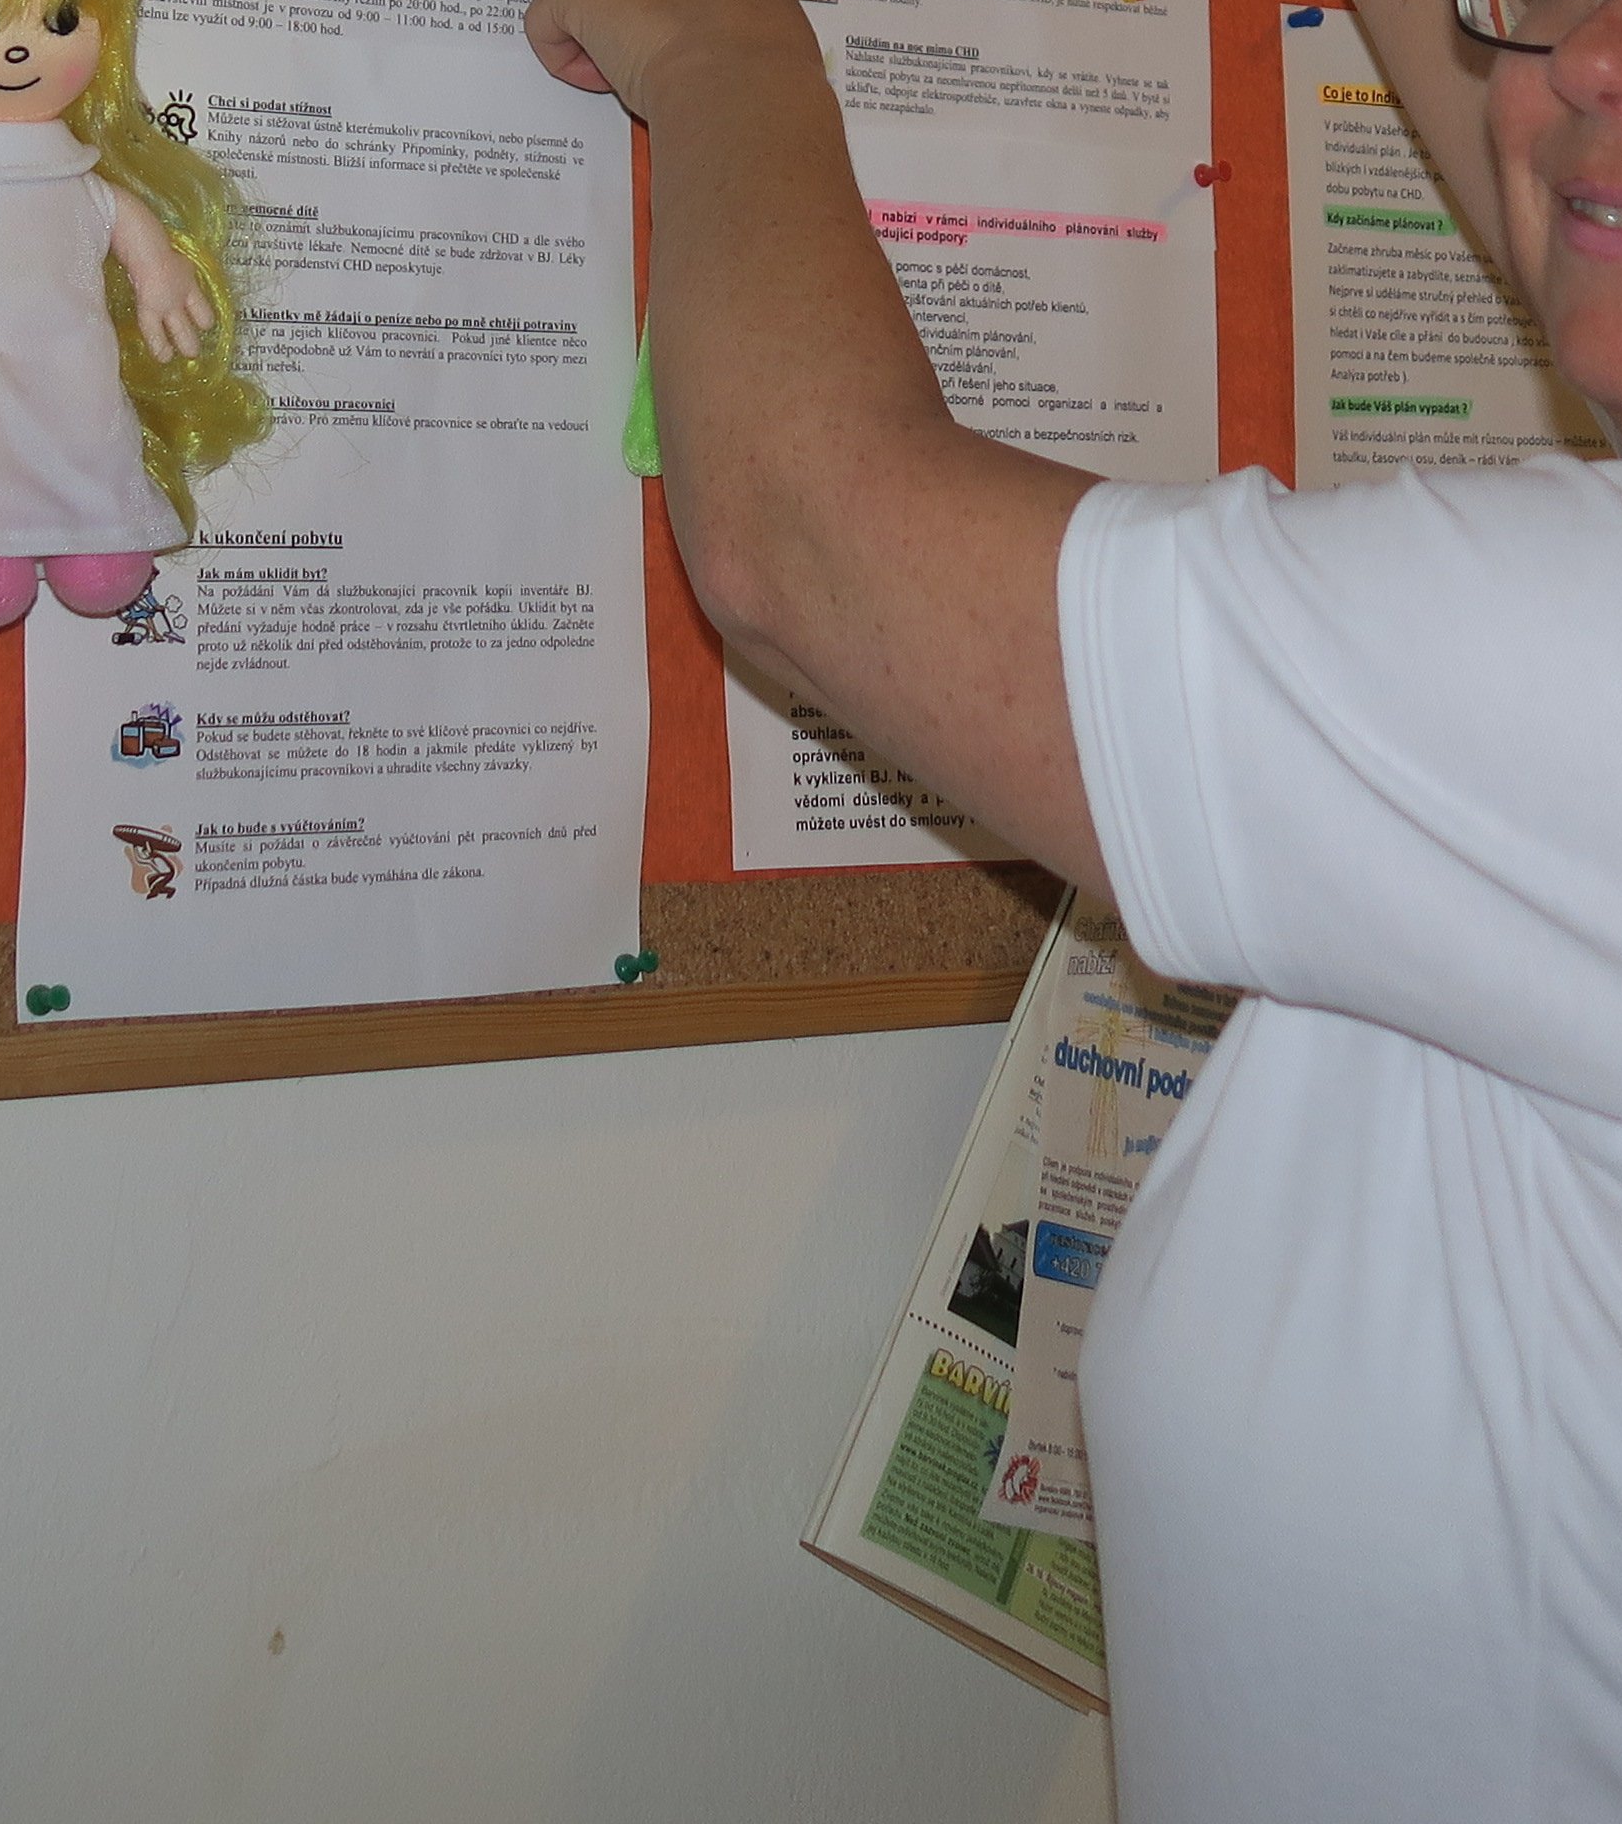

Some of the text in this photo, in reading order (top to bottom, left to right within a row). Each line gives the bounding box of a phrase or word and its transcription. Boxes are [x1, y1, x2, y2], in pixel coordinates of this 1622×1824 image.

[1322, 86, 1337, 101] Co
[1340, 90, 1352, 103] je
[1354, 89, 1369, 102] to
[207, 96, 332, 115] Chci si podat stížnost
[881, 210, 1157, 242] nabízí v rámci individuálního plánování služby
[250, 307, 577, 333] klientky mě žádají o peníze nebo po mně chtějí potraviny
[199, 529, 342, 548] k ukončení pobytu
[198, 567, 327, 582] Jak mám uklidit byt?
[196, 709, 350, 727] Kdy se můžu odstěhovat?
[791, 748, 864, 764] oprávněna
[793, 770, 891, 787] k vyklizení BJ.
[794, 792, 928, 808] vědomí důsledky a
[197, 818, 364, 836] Jak to bude s vyúčtováním?
[795, 814, 963, 830] můžete uvést do smlouvy
[1054, 1034, 1193, 1100] duchovní pod
